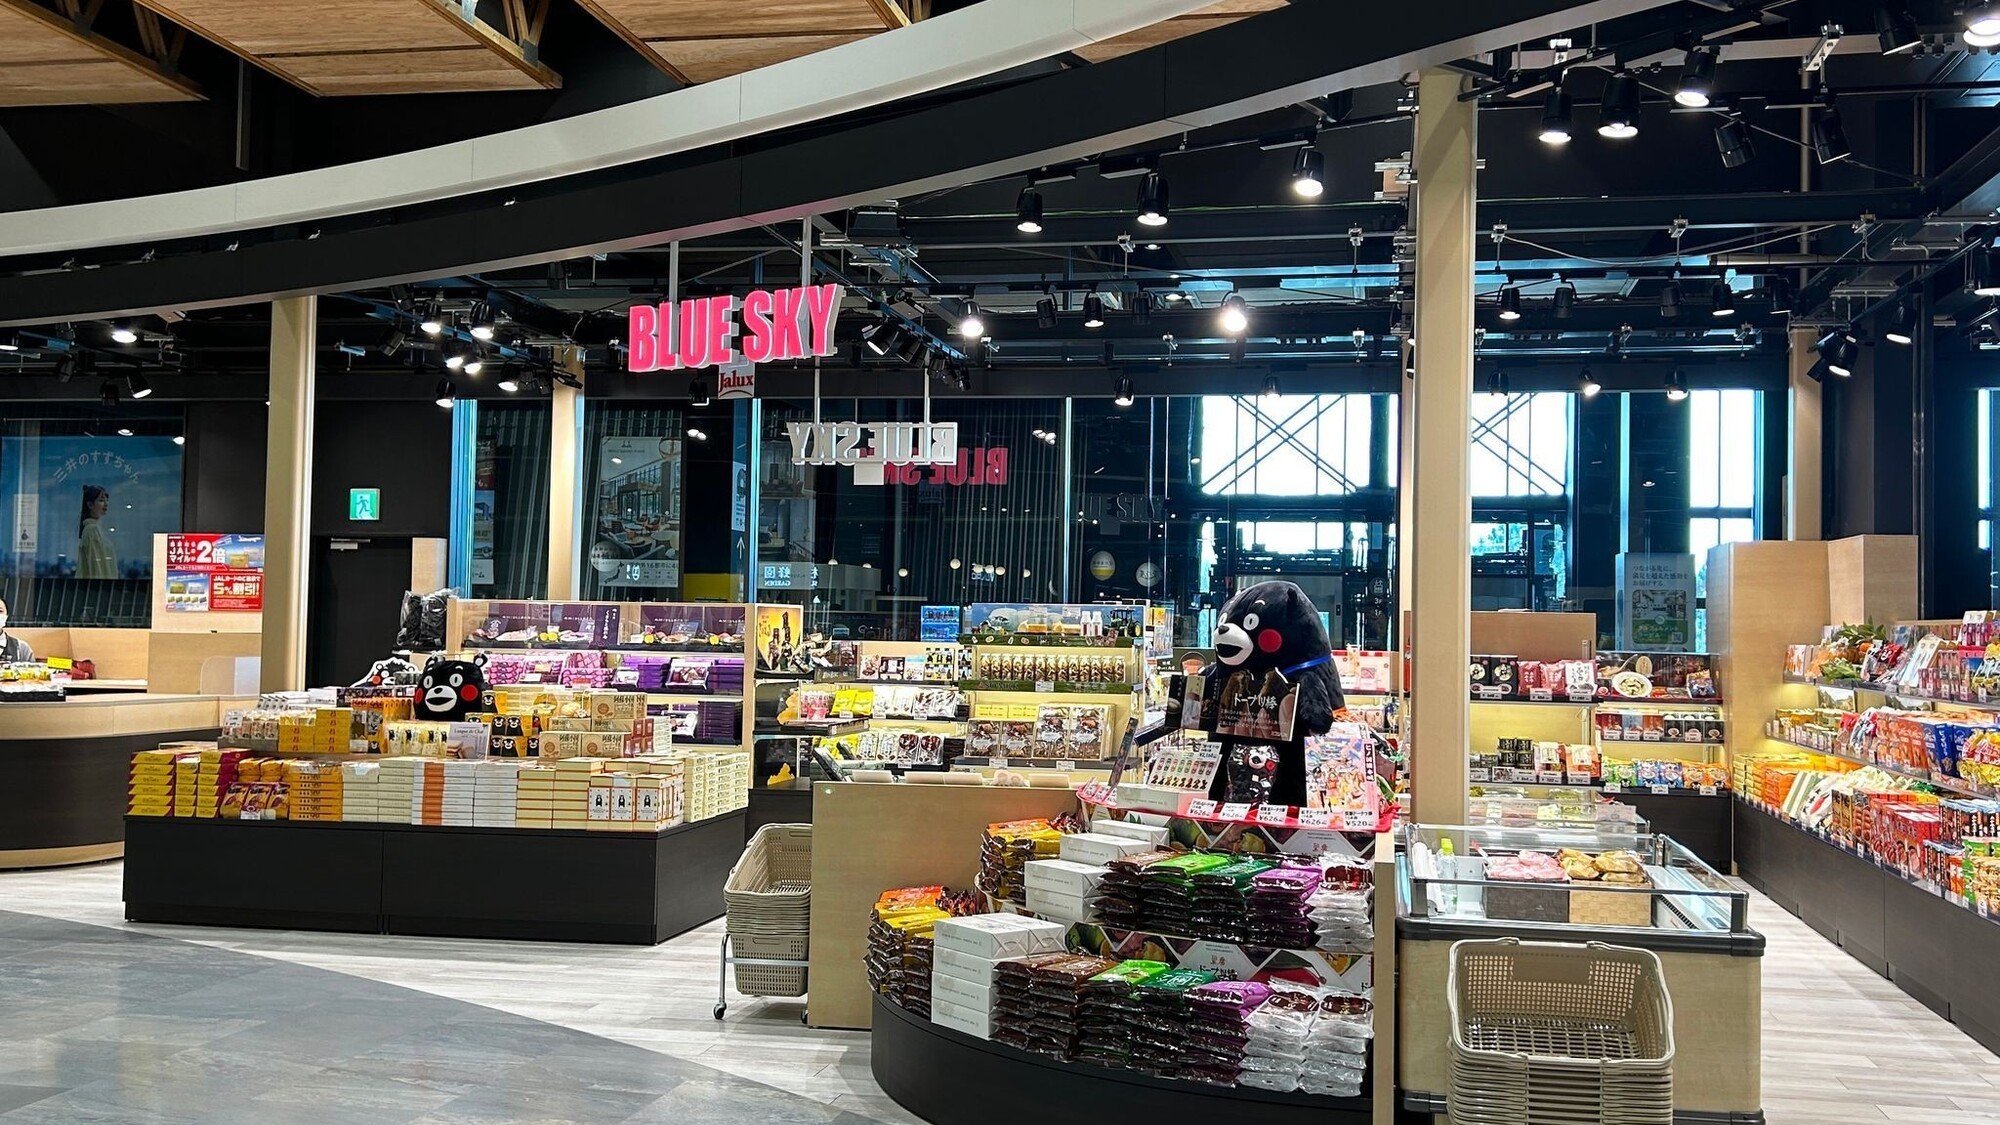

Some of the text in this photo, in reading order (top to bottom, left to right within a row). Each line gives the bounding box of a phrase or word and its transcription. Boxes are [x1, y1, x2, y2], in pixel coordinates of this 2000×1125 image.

[629, 283, 844, 372] BLUE SKY
[719, 370, 754, 392] Jalux
[196, 540, 226, 564] 2倍
